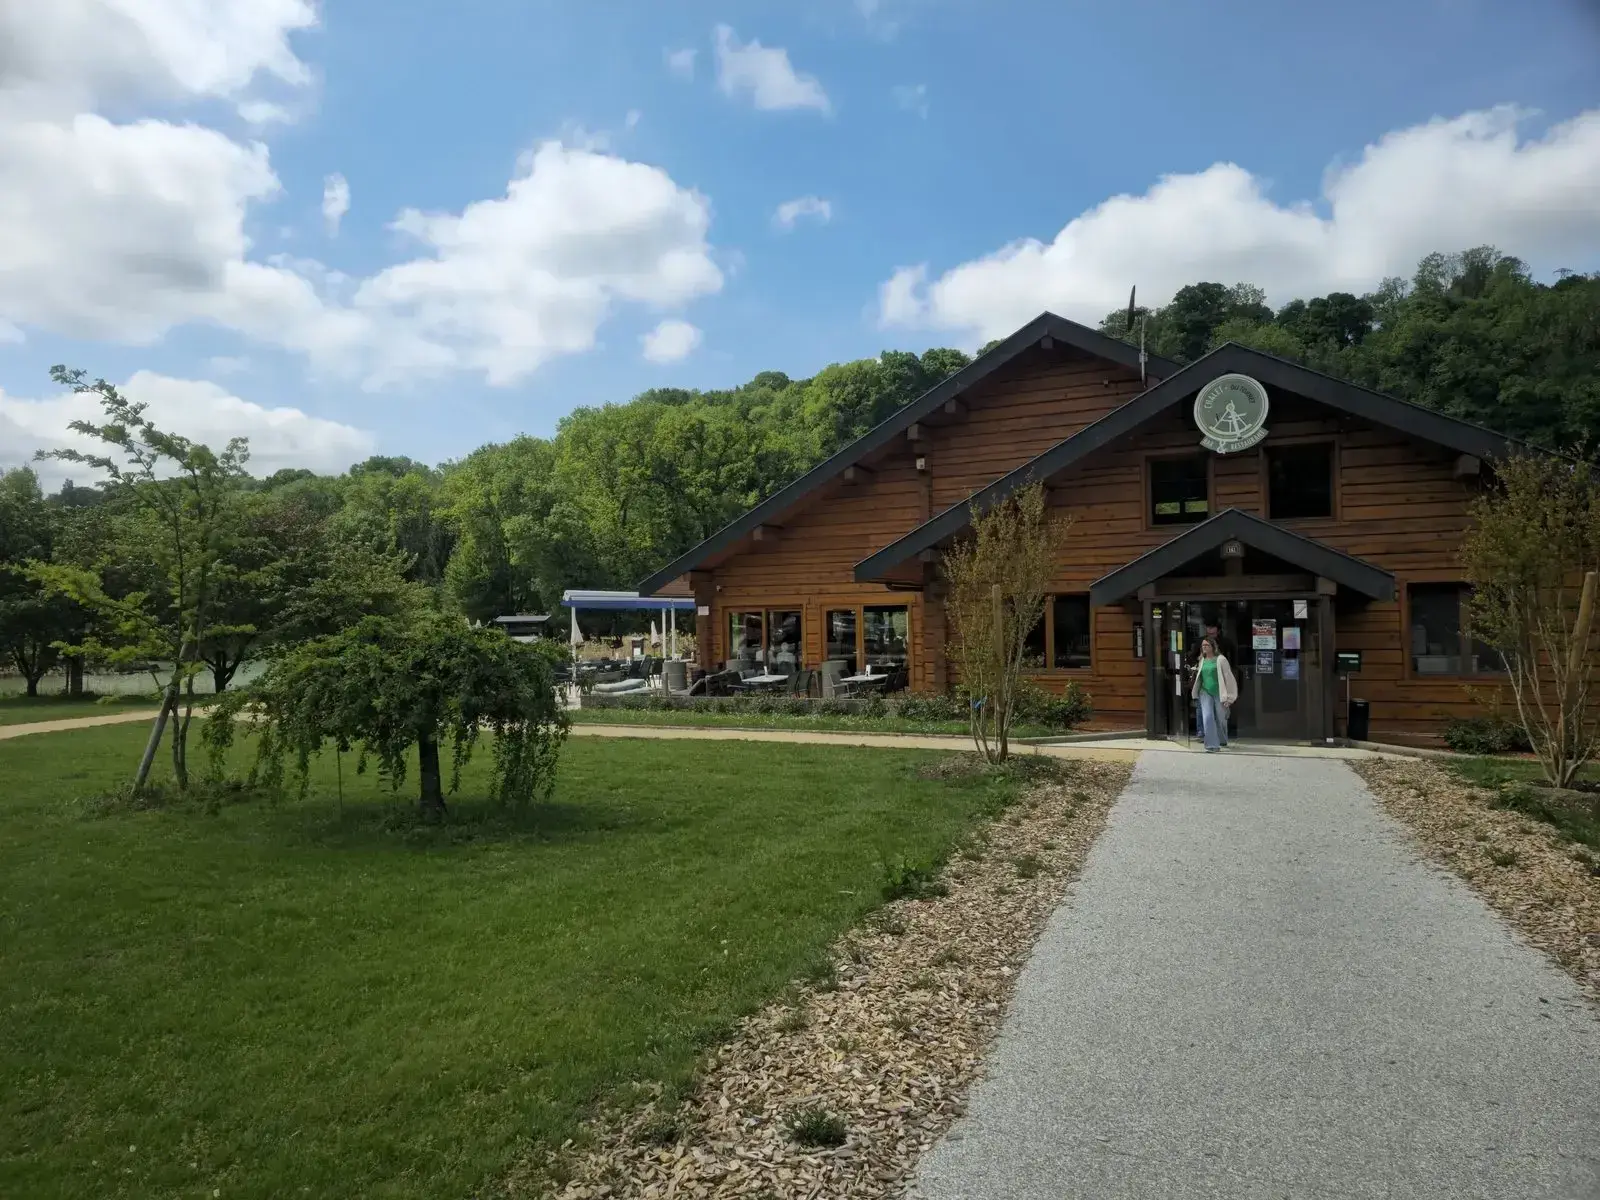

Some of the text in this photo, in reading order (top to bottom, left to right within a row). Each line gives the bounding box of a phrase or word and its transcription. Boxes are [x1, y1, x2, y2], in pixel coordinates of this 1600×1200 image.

[1204, 386, 1224, 409] CHALET
[1216, 440, 1227, 455] &
[1230, 430, 1265, 450] RESTAURANT
